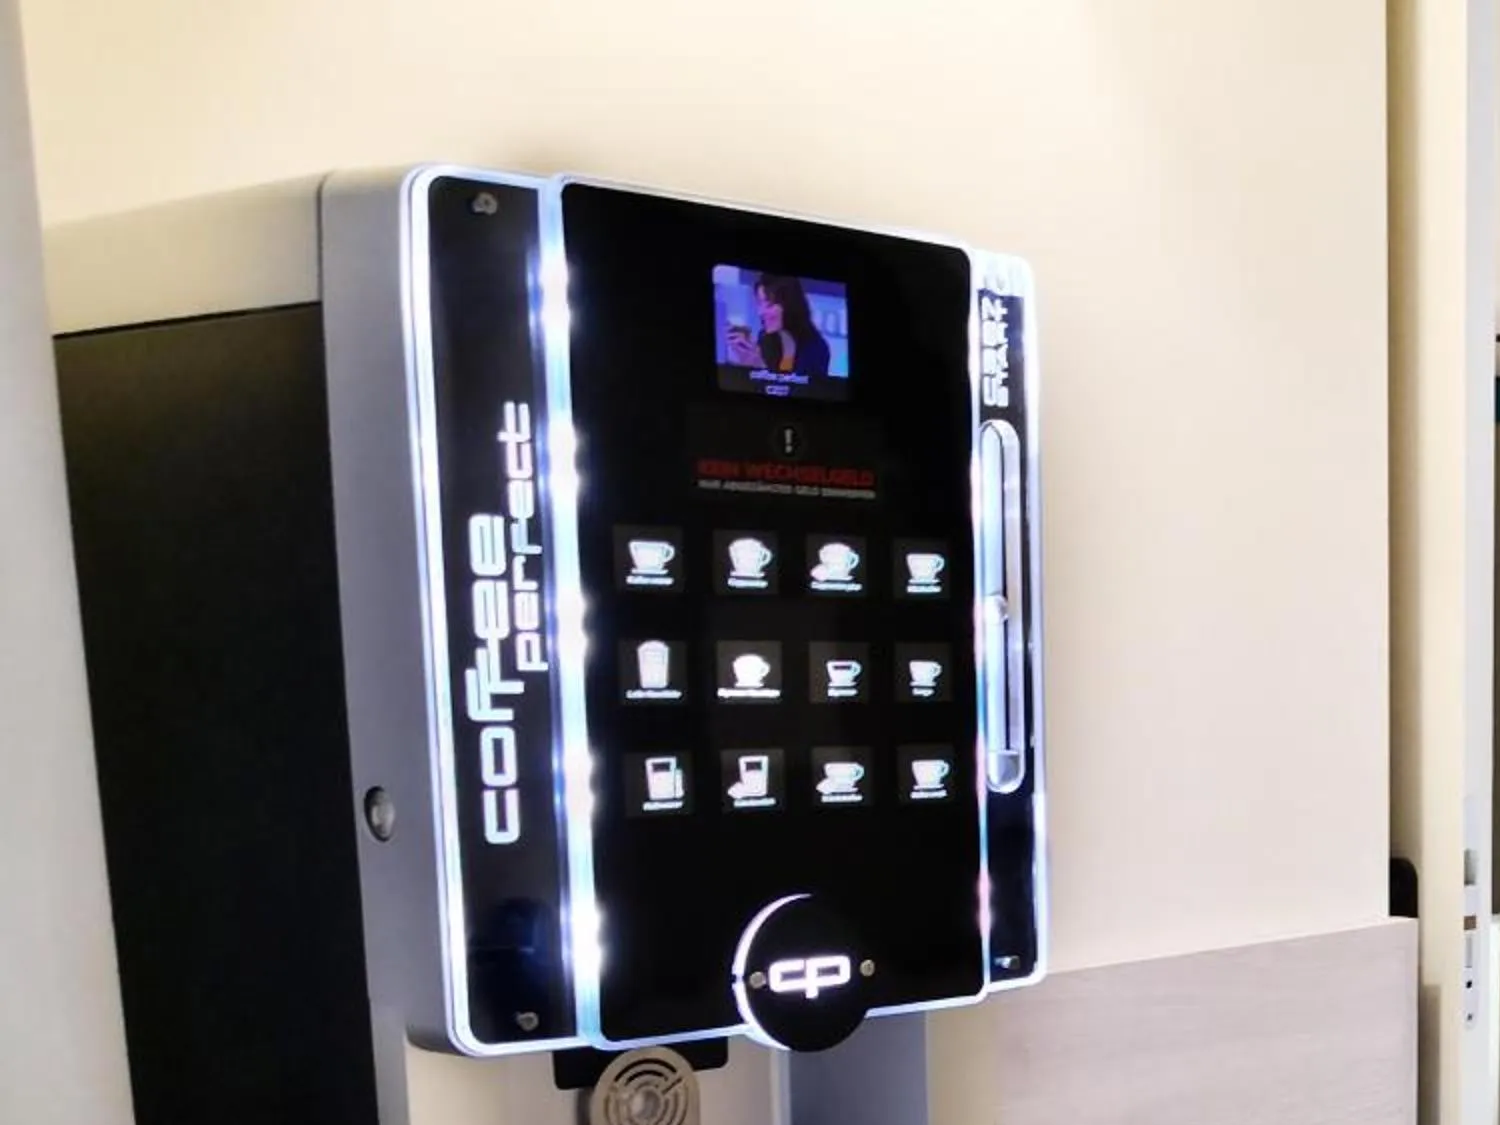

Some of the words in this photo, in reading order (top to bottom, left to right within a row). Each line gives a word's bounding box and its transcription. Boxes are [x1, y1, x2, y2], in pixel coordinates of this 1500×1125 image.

[497, 400, 549, 673] perfect
[465, 512, 524, 846] coffee
[767, 954, 851, 1000] cp
